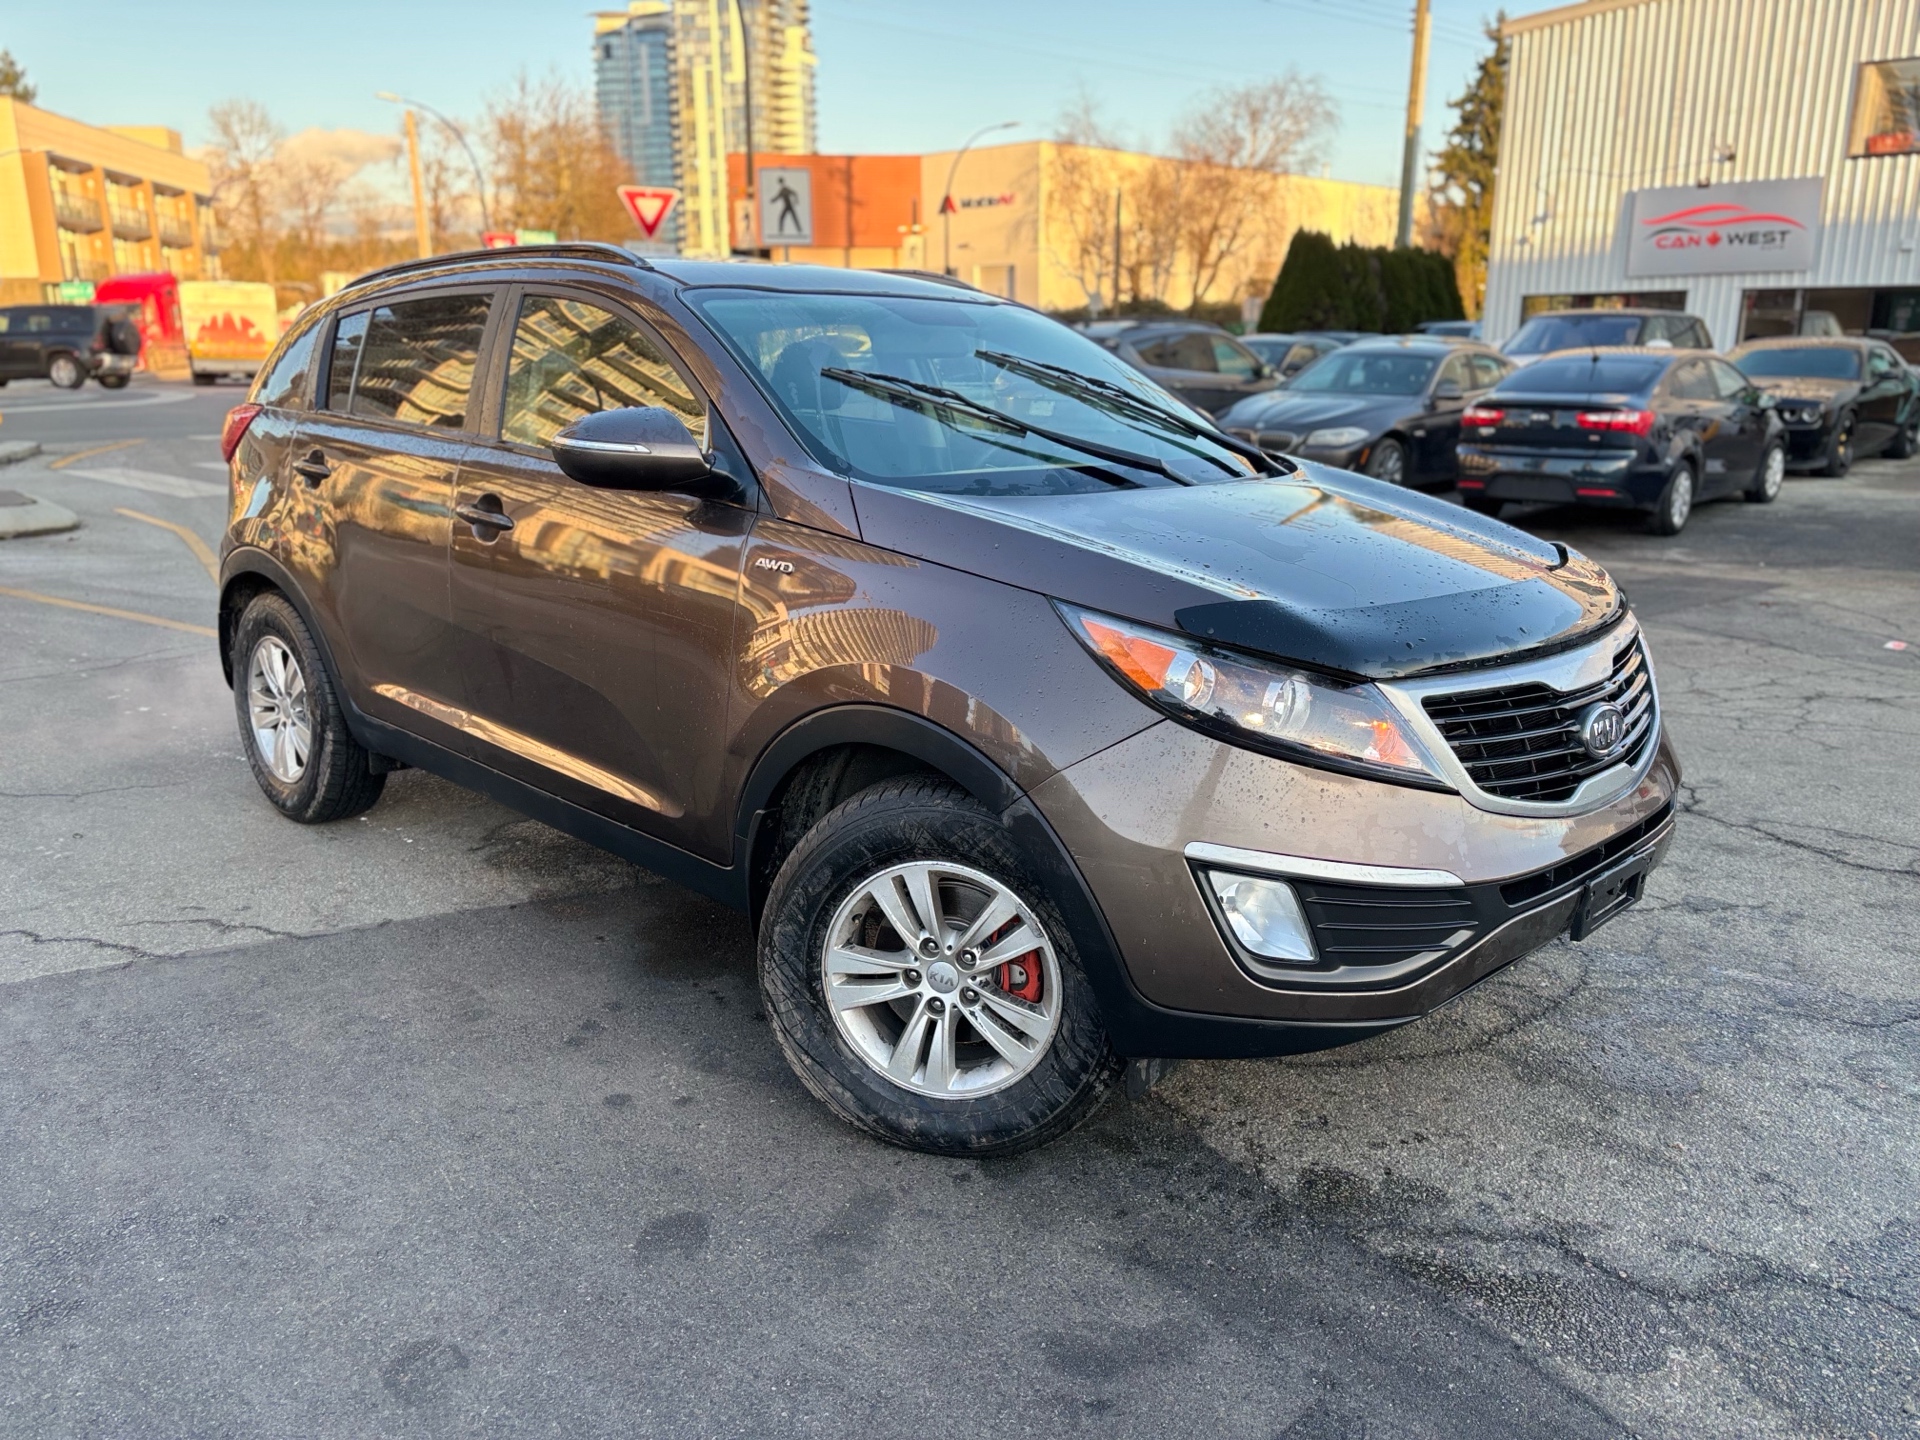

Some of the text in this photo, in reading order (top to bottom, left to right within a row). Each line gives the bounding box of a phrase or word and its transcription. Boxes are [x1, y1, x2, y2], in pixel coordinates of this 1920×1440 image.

[1655, 230, 1790, 249] CAN WEST
[755, 557, 794, 574] AWD
[929, 972, 954, 987] KIA
